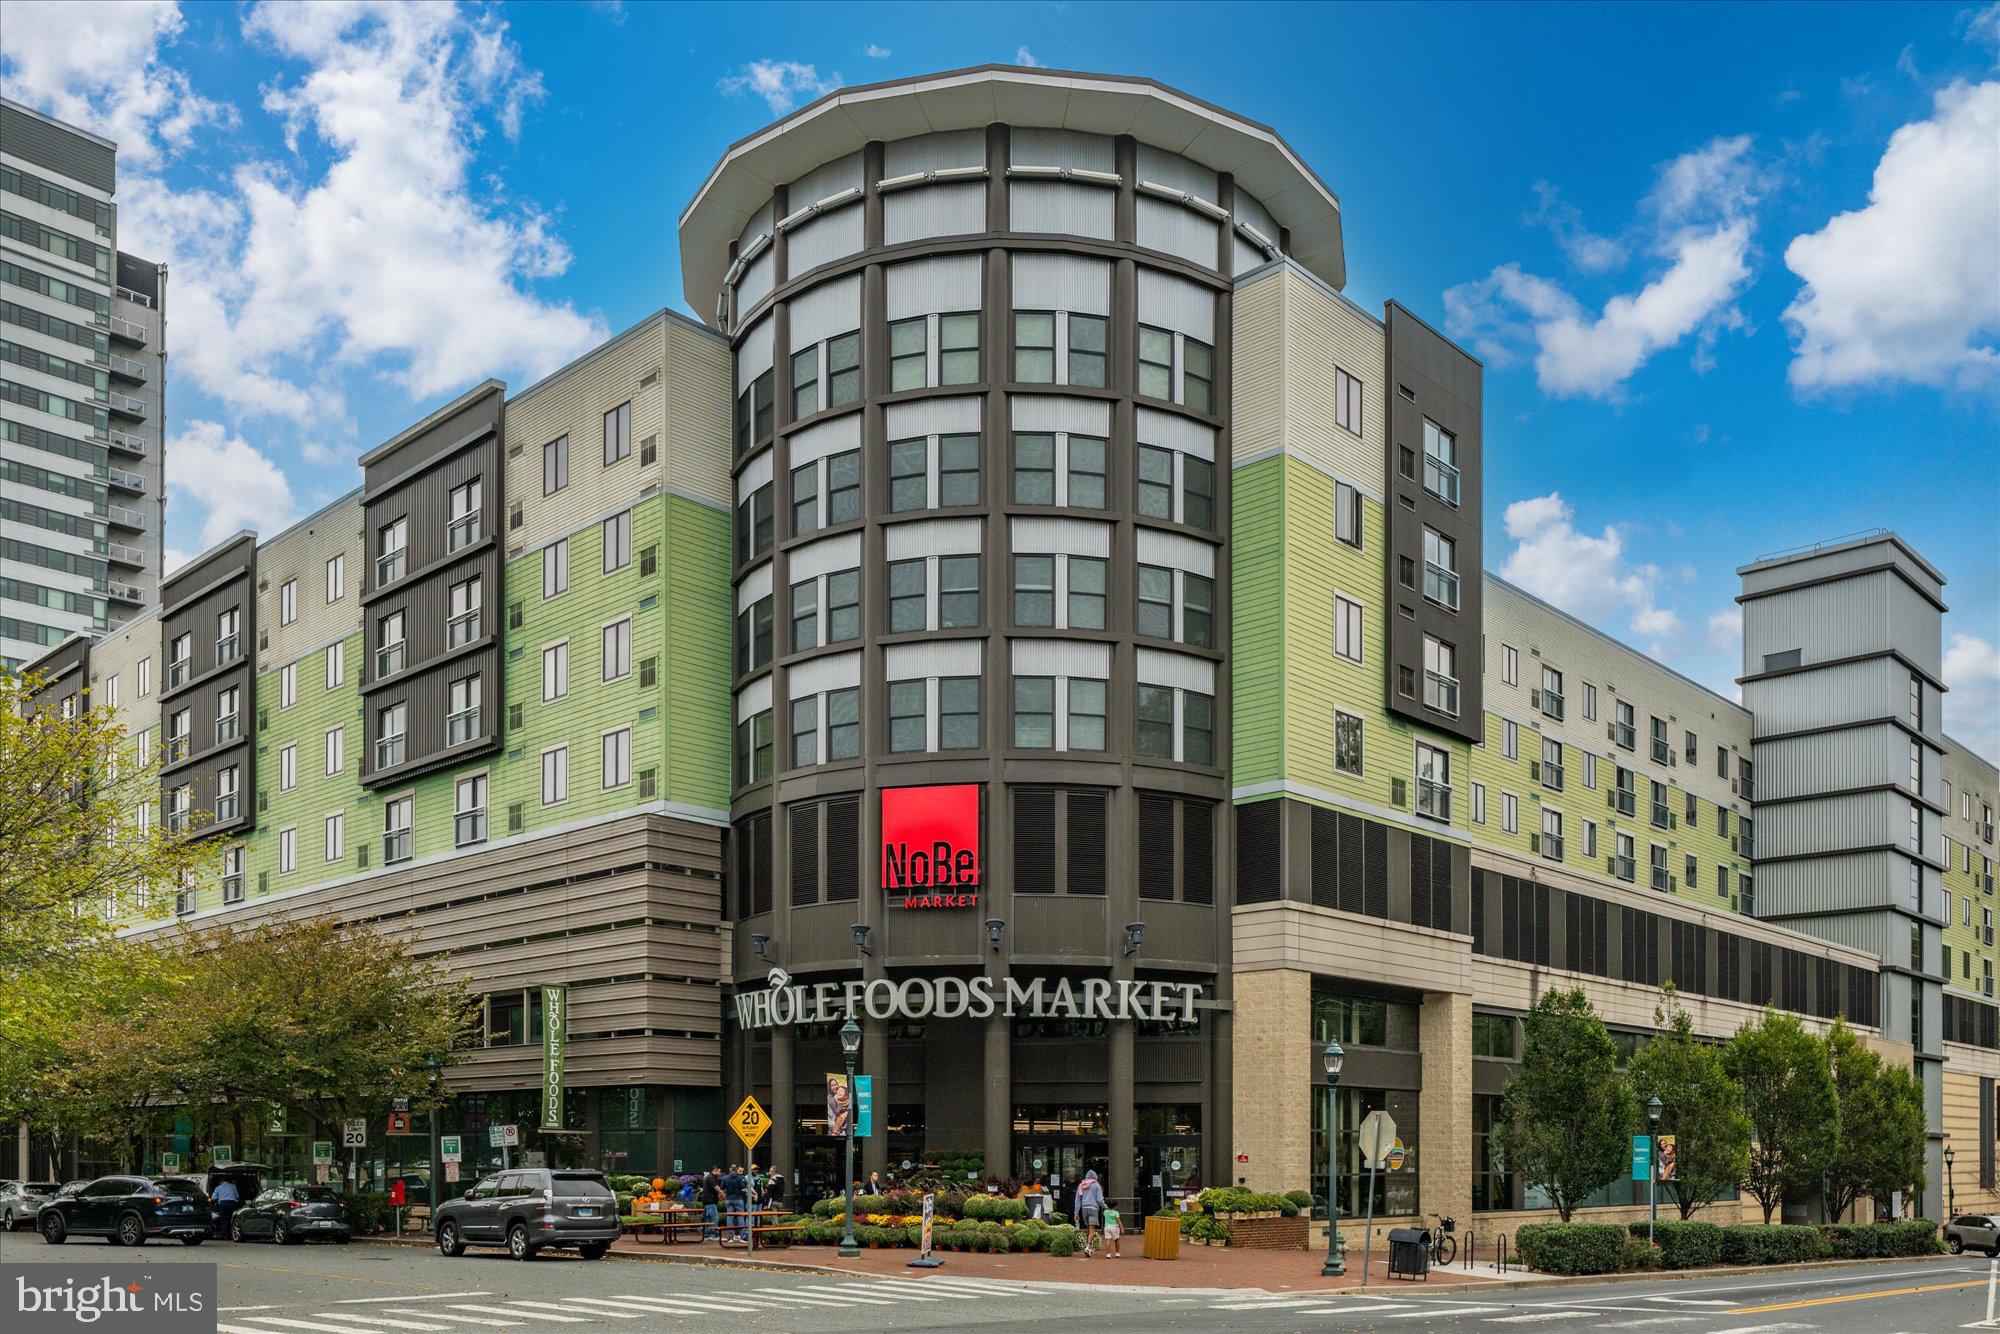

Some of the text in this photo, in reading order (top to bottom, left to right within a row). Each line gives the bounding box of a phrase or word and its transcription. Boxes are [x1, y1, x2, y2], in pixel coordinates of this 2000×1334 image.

[886, 841, 975, 888] NoBe
[905, 895, 978, 909] MARKET
[546, 988, 560, 1056] WHOLE
[735, 967, 1203, 1030] WHOLE FOODS MARKET
[548, 1060, 560, 1122] FOODS
[346, 1133, 364, 1144] 20
[742, 1110, 760, 1125] 20
